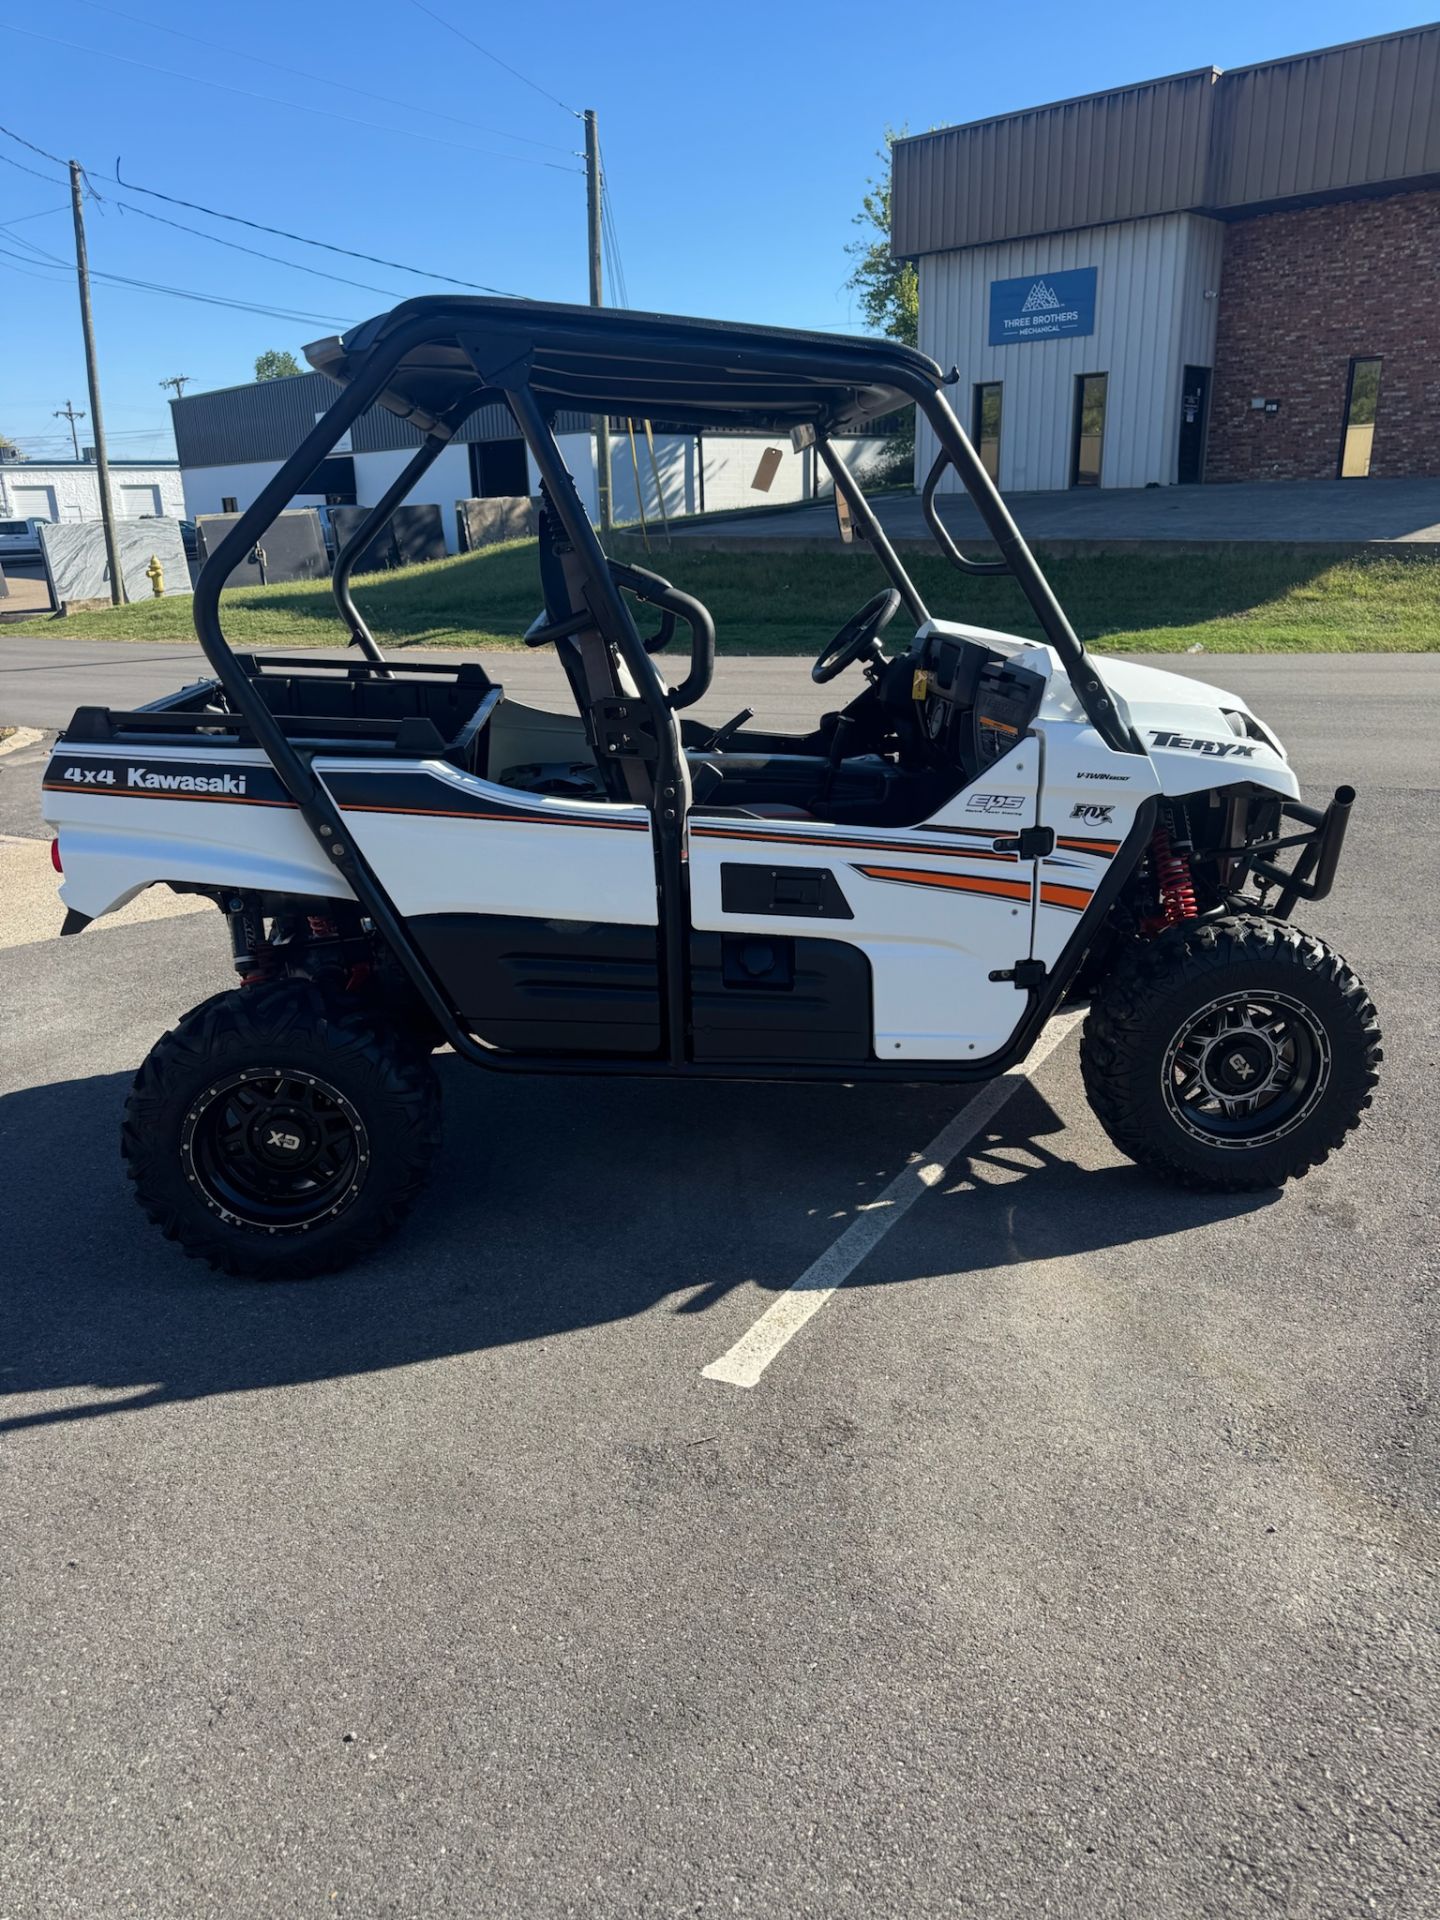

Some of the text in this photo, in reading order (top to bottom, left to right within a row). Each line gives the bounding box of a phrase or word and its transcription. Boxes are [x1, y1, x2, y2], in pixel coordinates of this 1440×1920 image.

[1004, 311, 1078, 328] THREE BROTHERS
[1019, 324, 1060, 335] MECHANICAL
[1148, 730, 1257, 757] TERYX
[64, 767, 246, 794] 4x4 Kawasaki
[1070, 803, 1115, 824] FOX
